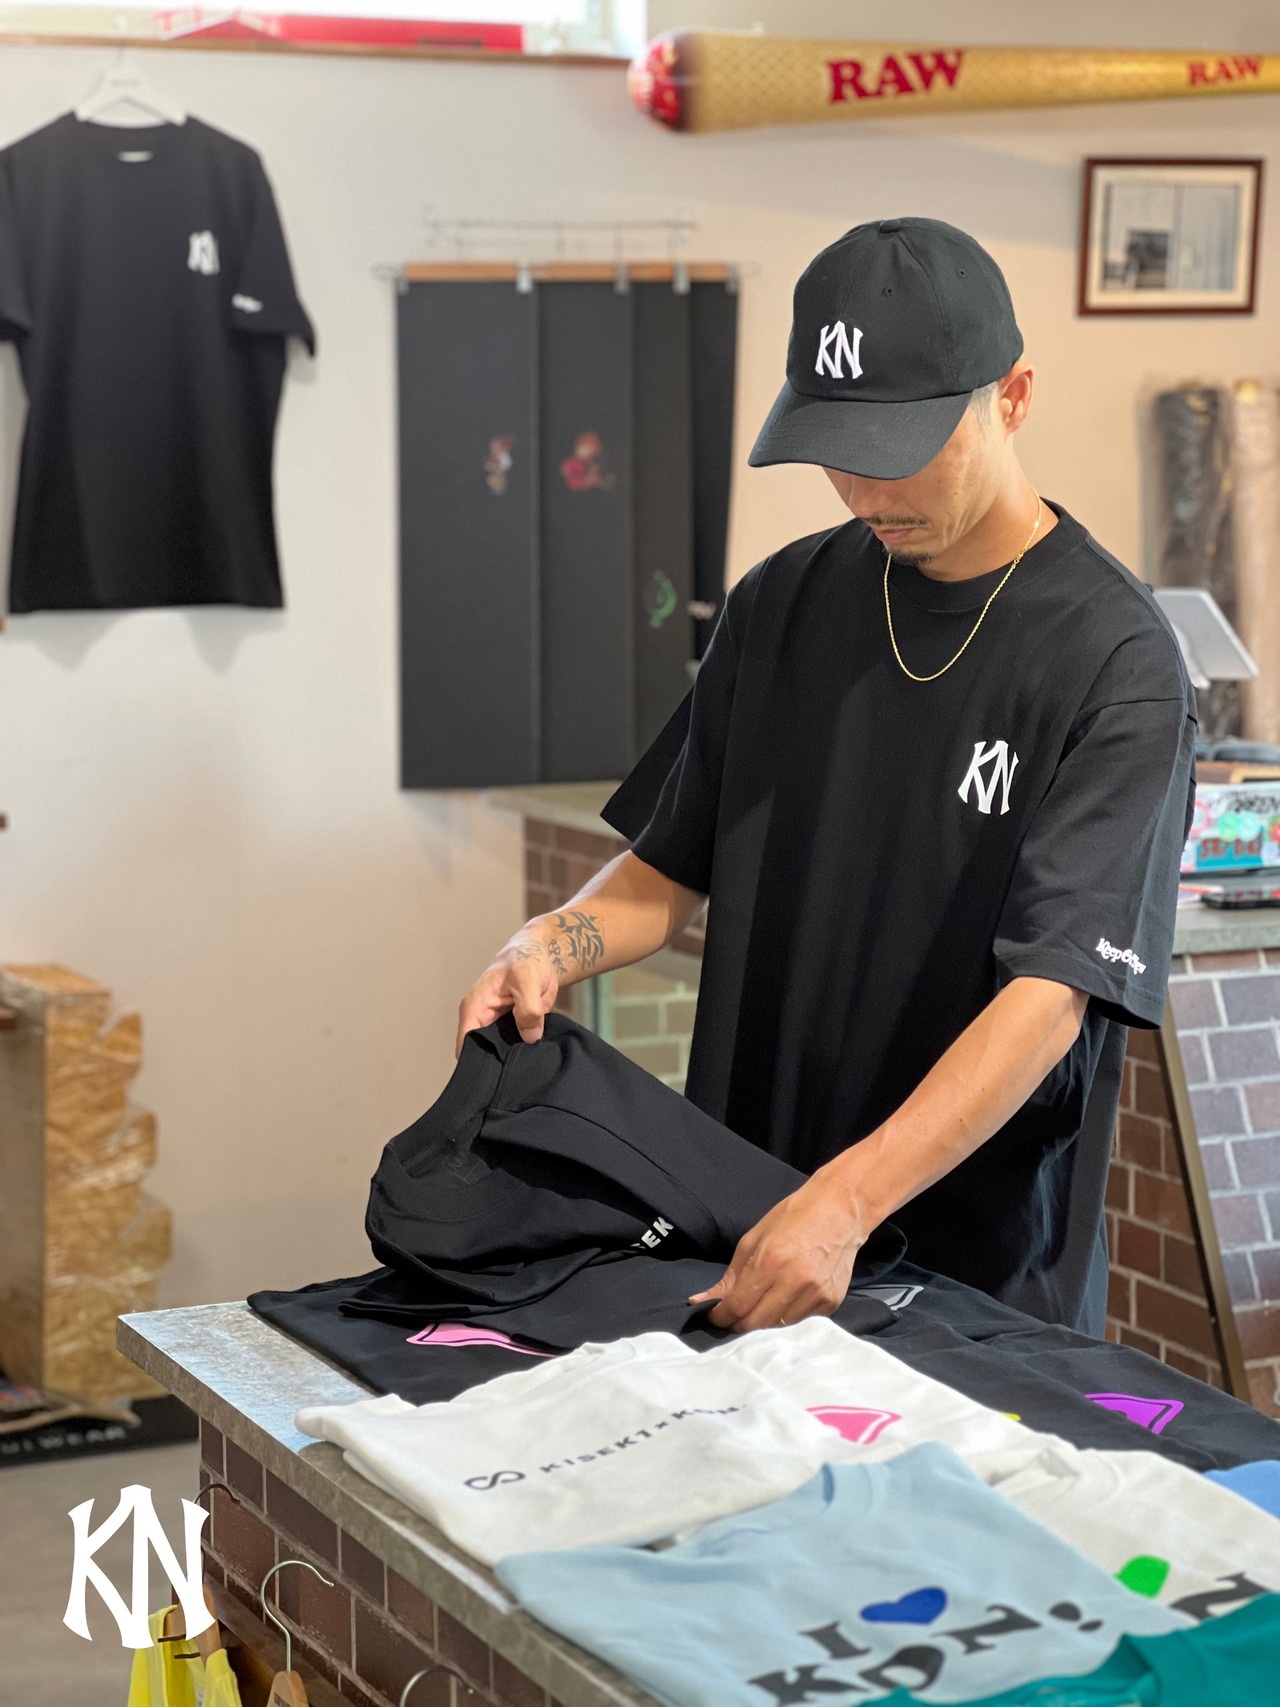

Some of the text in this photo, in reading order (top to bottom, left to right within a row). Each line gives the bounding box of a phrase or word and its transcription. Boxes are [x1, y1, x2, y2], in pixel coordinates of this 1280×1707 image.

[827, 48, 965, 105] RAW
[1188, 54, 1264, 87] RAW
[814, 320, 864, 379] KN
[957, 740, 1019, 815] KN
[630, 1216, 675, 1249] EK
[797, 1620, 872, 1661] I
